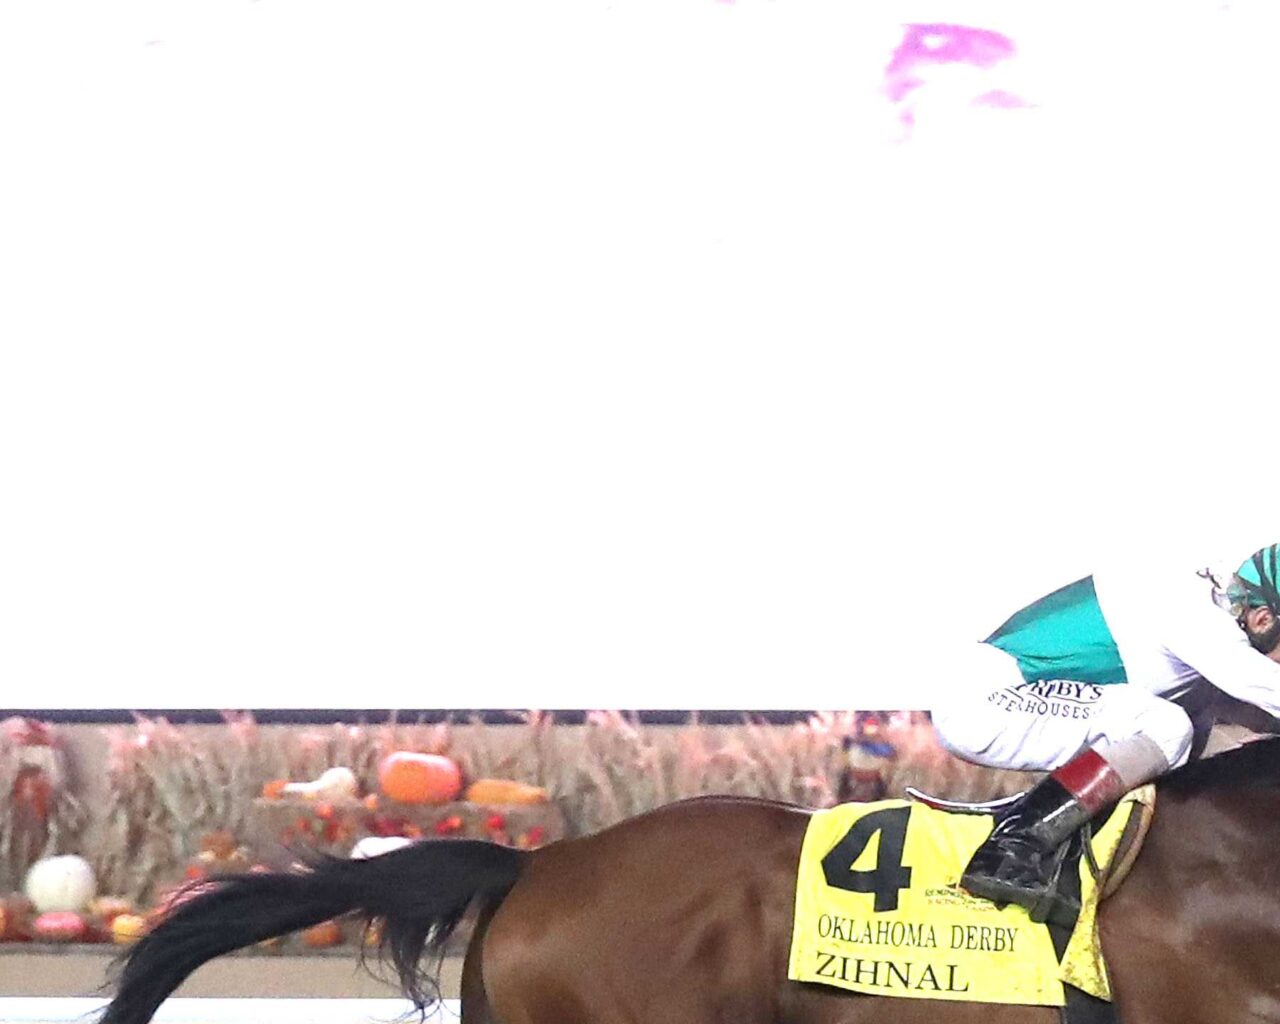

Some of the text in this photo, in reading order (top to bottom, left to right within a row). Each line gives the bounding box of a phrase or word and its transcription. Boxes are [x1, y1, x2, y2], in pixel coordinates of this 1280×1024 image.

[820, 806, 913, 912] 4
[817, 914, 1018, 952] OKLAHOMA DERBY
[815, 952, 970, 993] ZIHNAL
